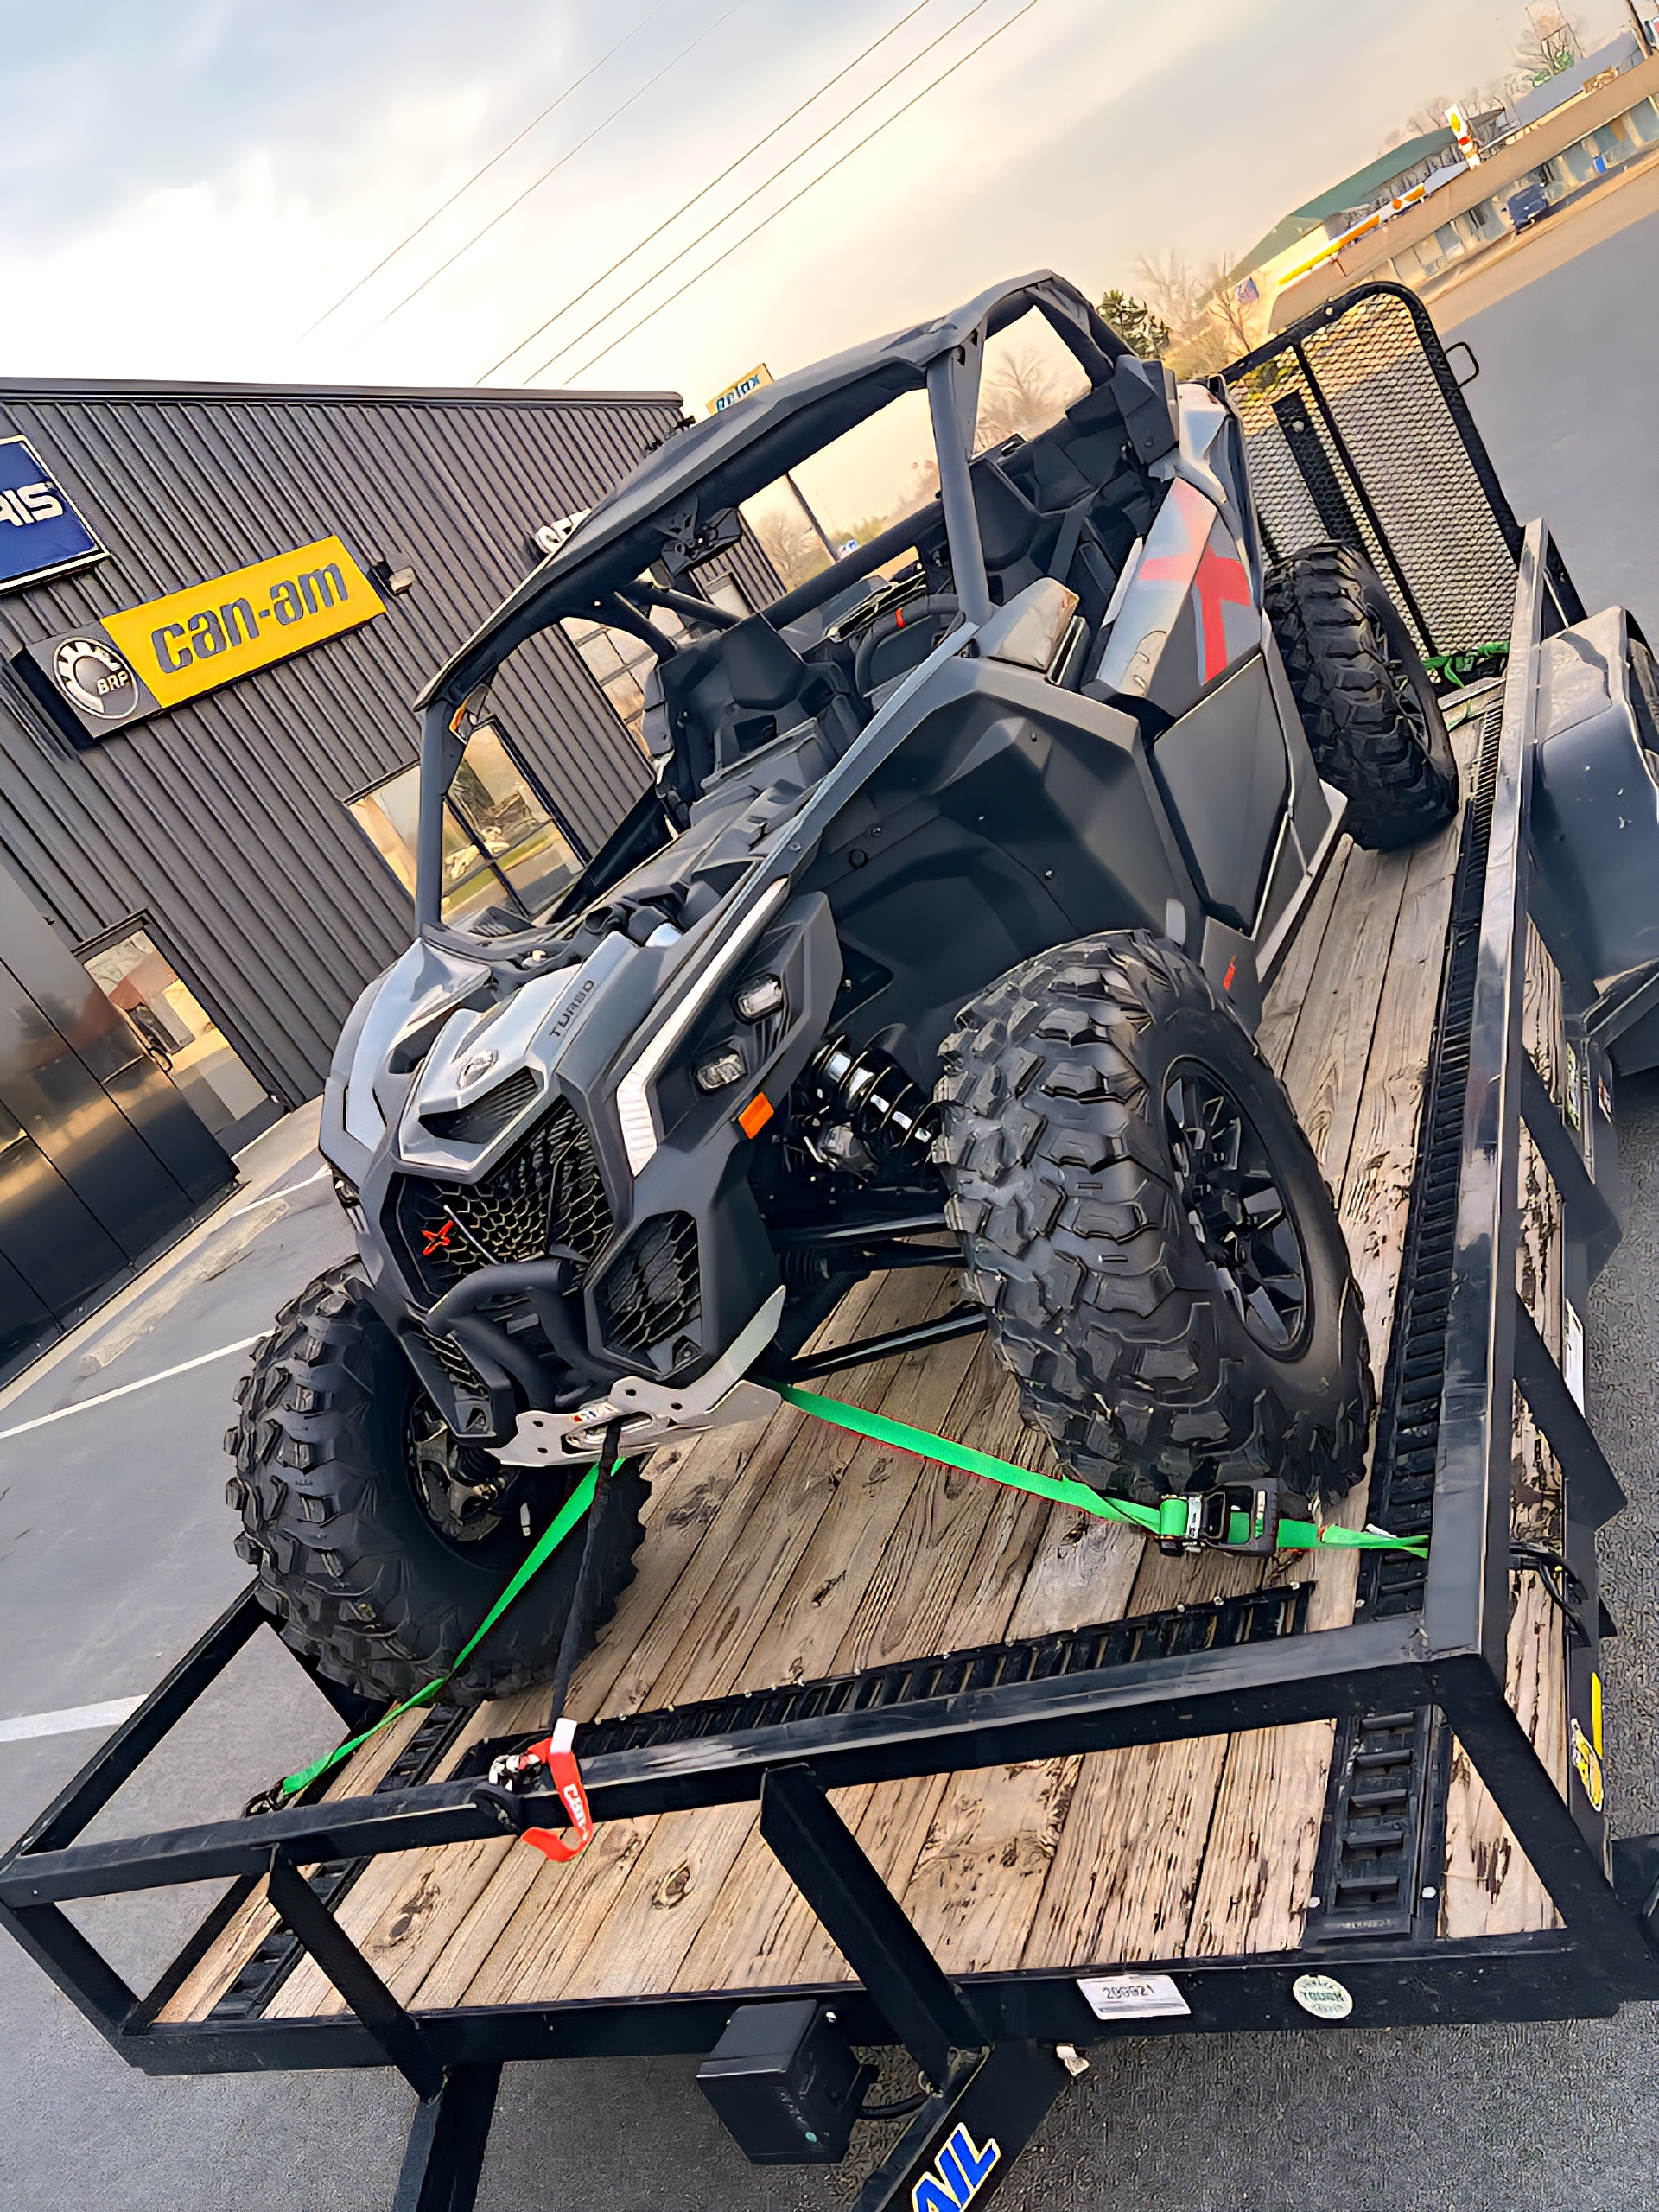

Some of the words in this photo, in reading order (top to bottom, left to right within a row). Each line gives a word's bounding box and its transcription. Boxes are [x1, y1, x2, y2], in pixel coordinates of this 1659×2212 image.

[150, 563, 349, 674] can-am
[97, 671, 130, 695] BRP
[549, 979, 594, 1037] TURBO
